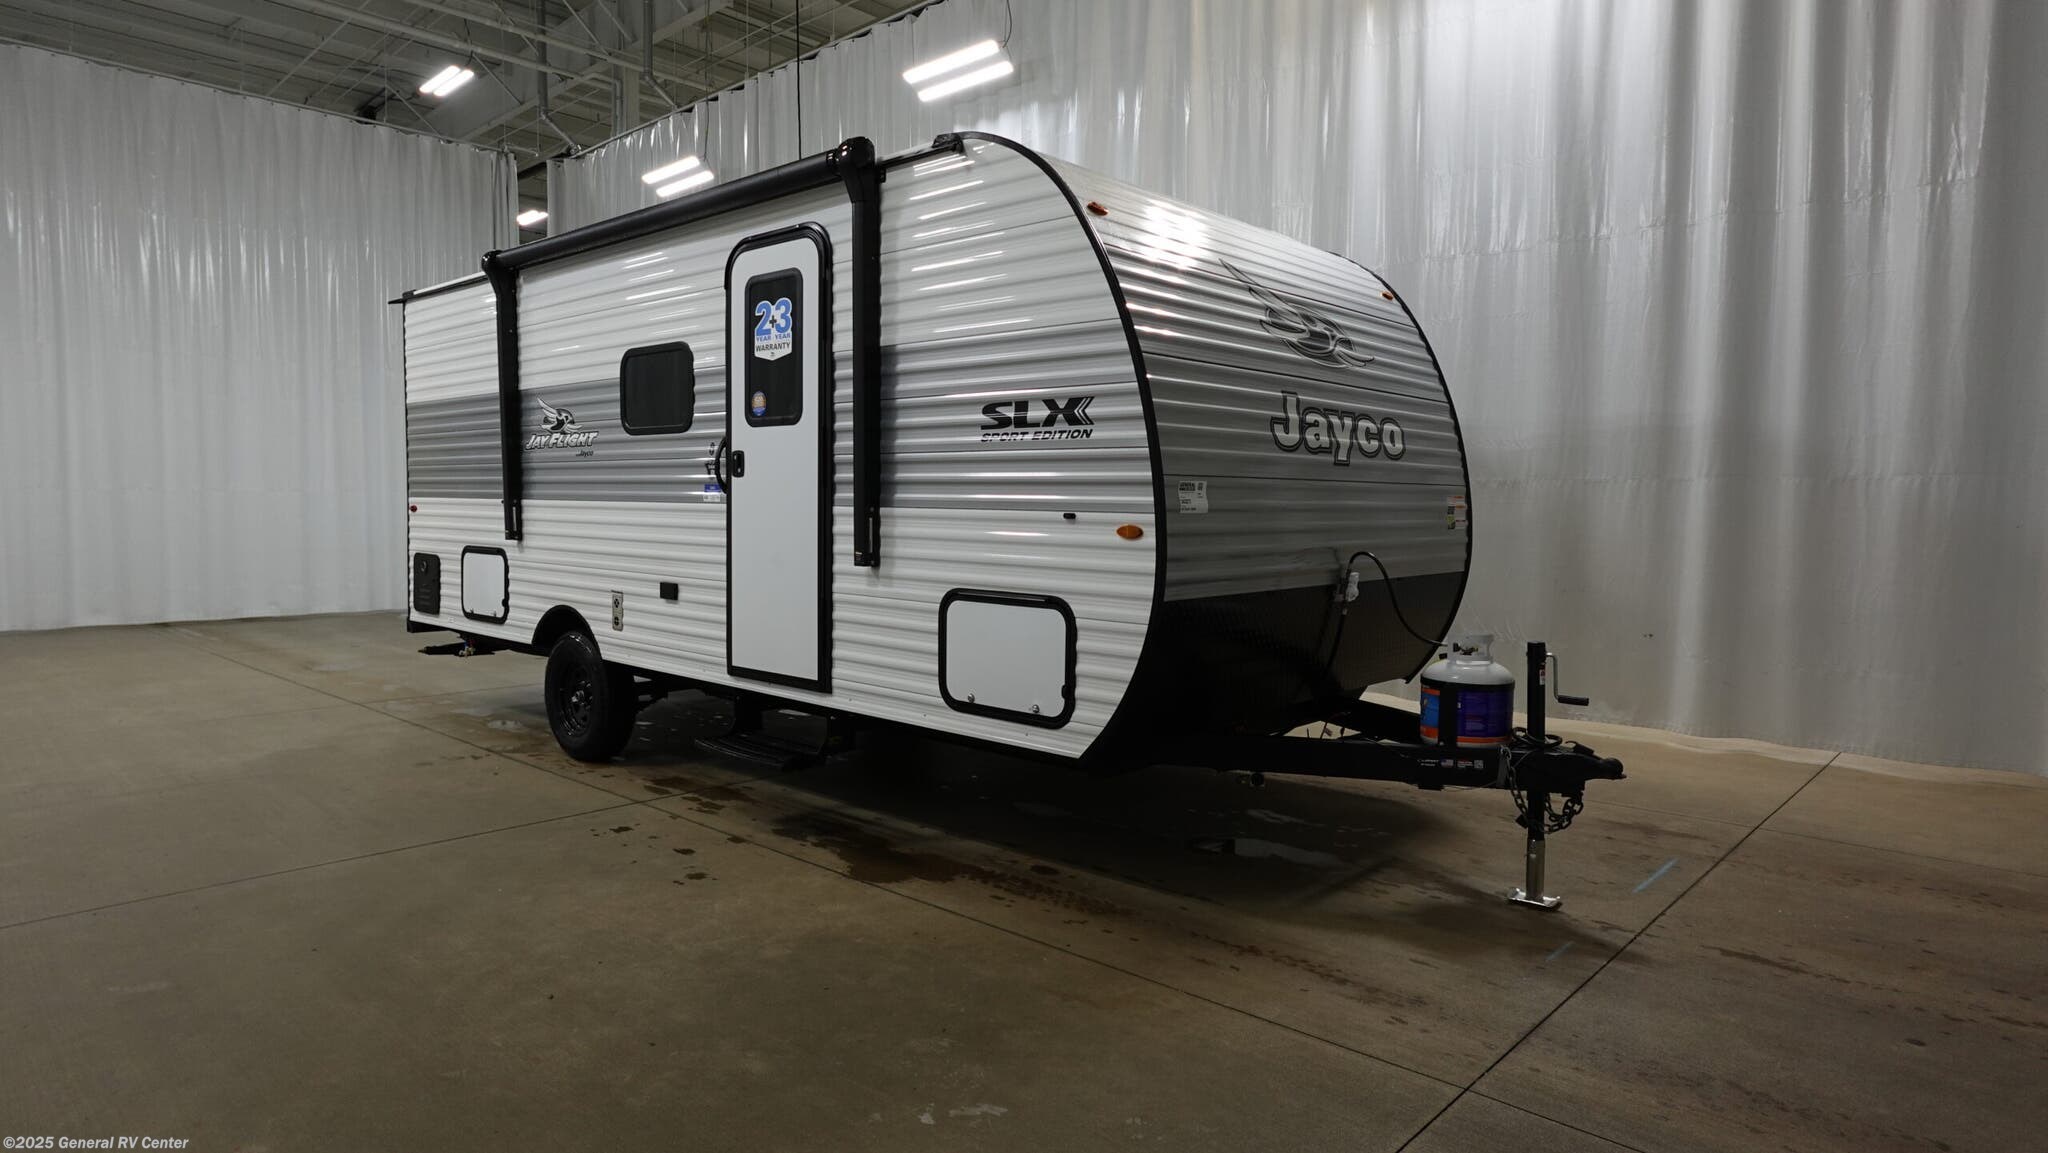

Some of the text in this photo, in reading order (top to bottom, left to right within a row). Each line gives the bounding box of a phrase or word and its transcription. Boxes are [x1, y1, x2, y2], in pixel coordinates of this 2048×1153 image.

[756, 342, 790, 352] WARRANTY
[981, 397, 1094, 430] SLX
[981, 429, 1093, 442] SPORT EDITION
[1270, 390, 1406, 467] Jayco
[525, 431, 599, 453] JAY FLIGHT
